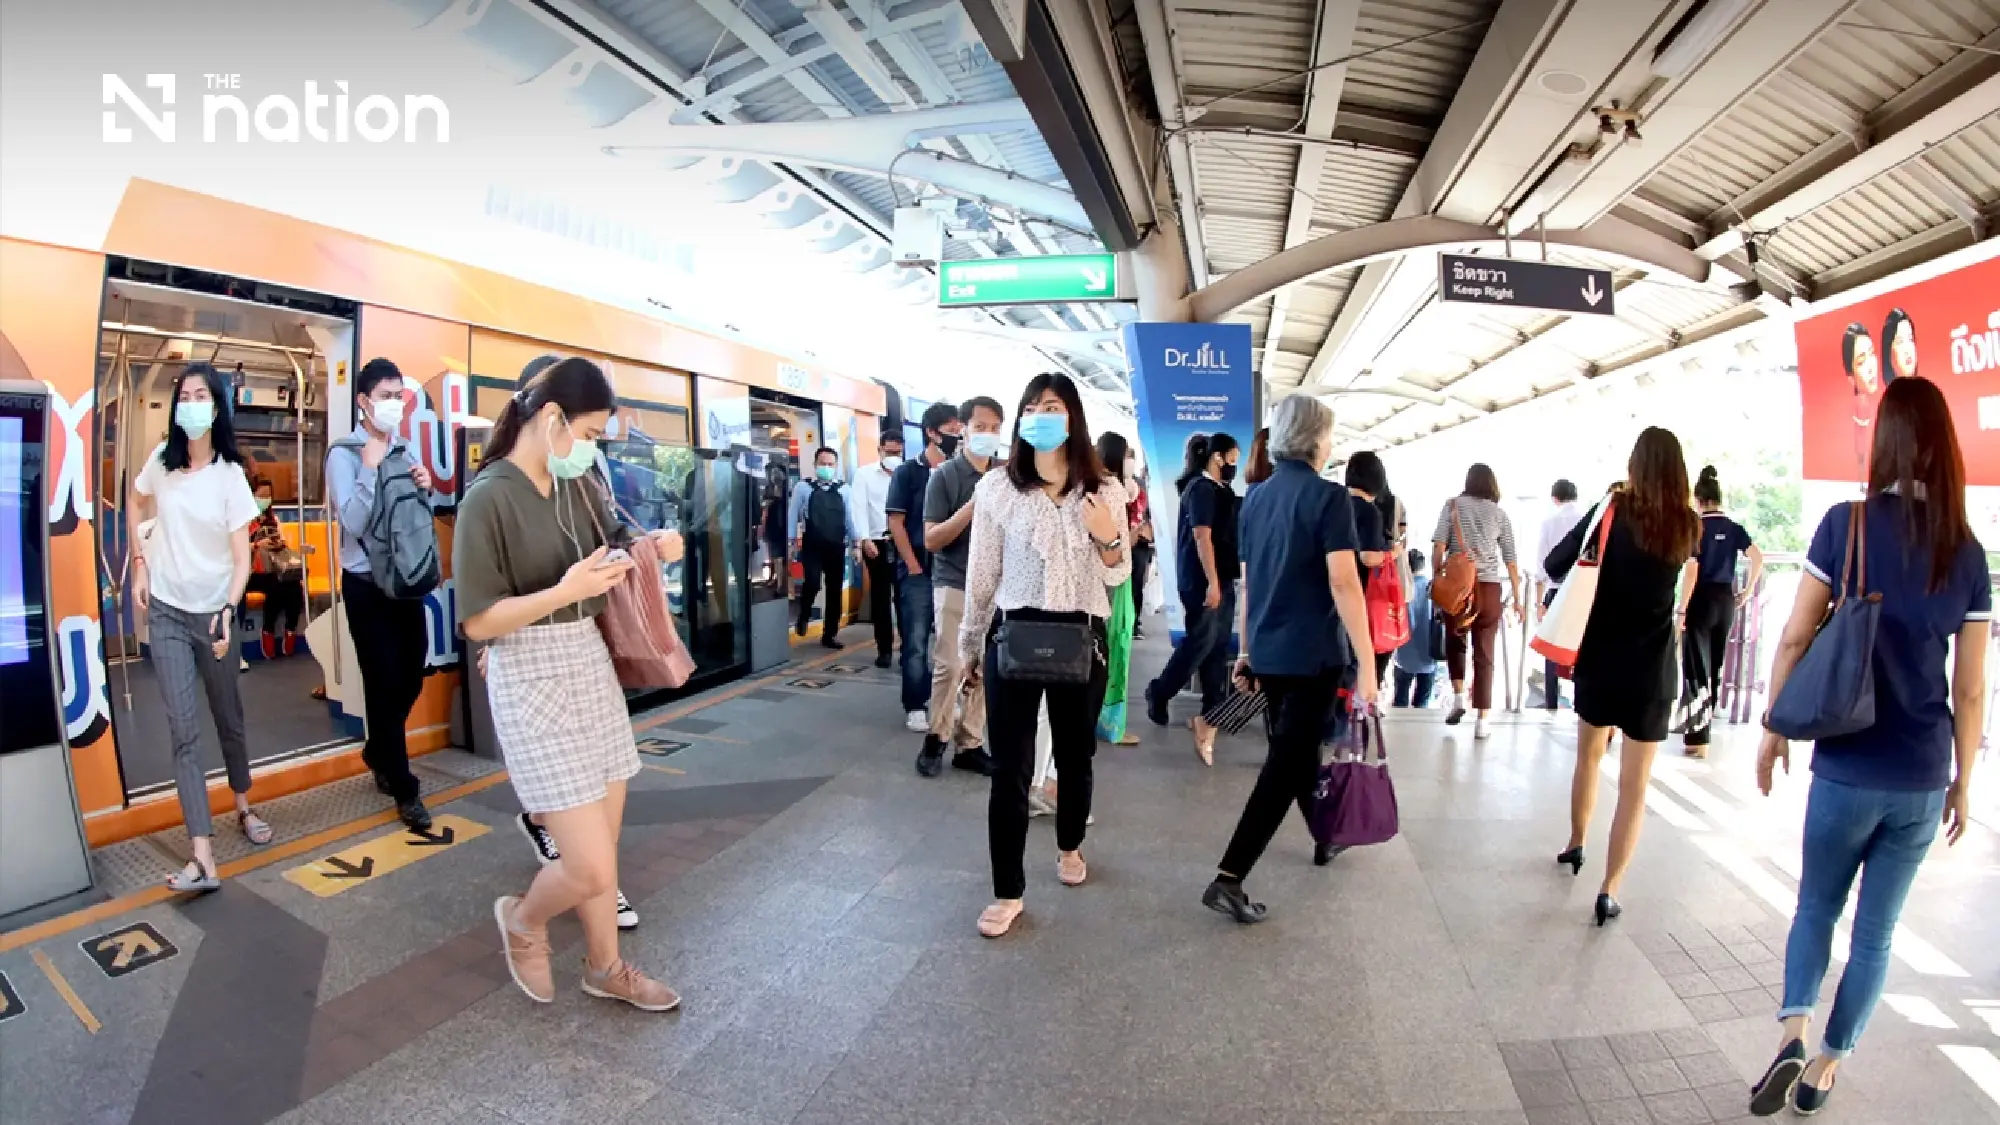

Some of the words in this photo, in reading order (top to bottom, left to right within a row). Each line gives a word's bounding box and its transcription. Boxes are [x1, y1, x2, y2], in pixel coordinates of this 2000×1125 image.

[1452, 261, 1507, 283] ชิดขวา
[948, 285, 977, 298] Exit
[1452, 283, 1483, 298] Keep
[1484, 285, 1515, 301] Right
